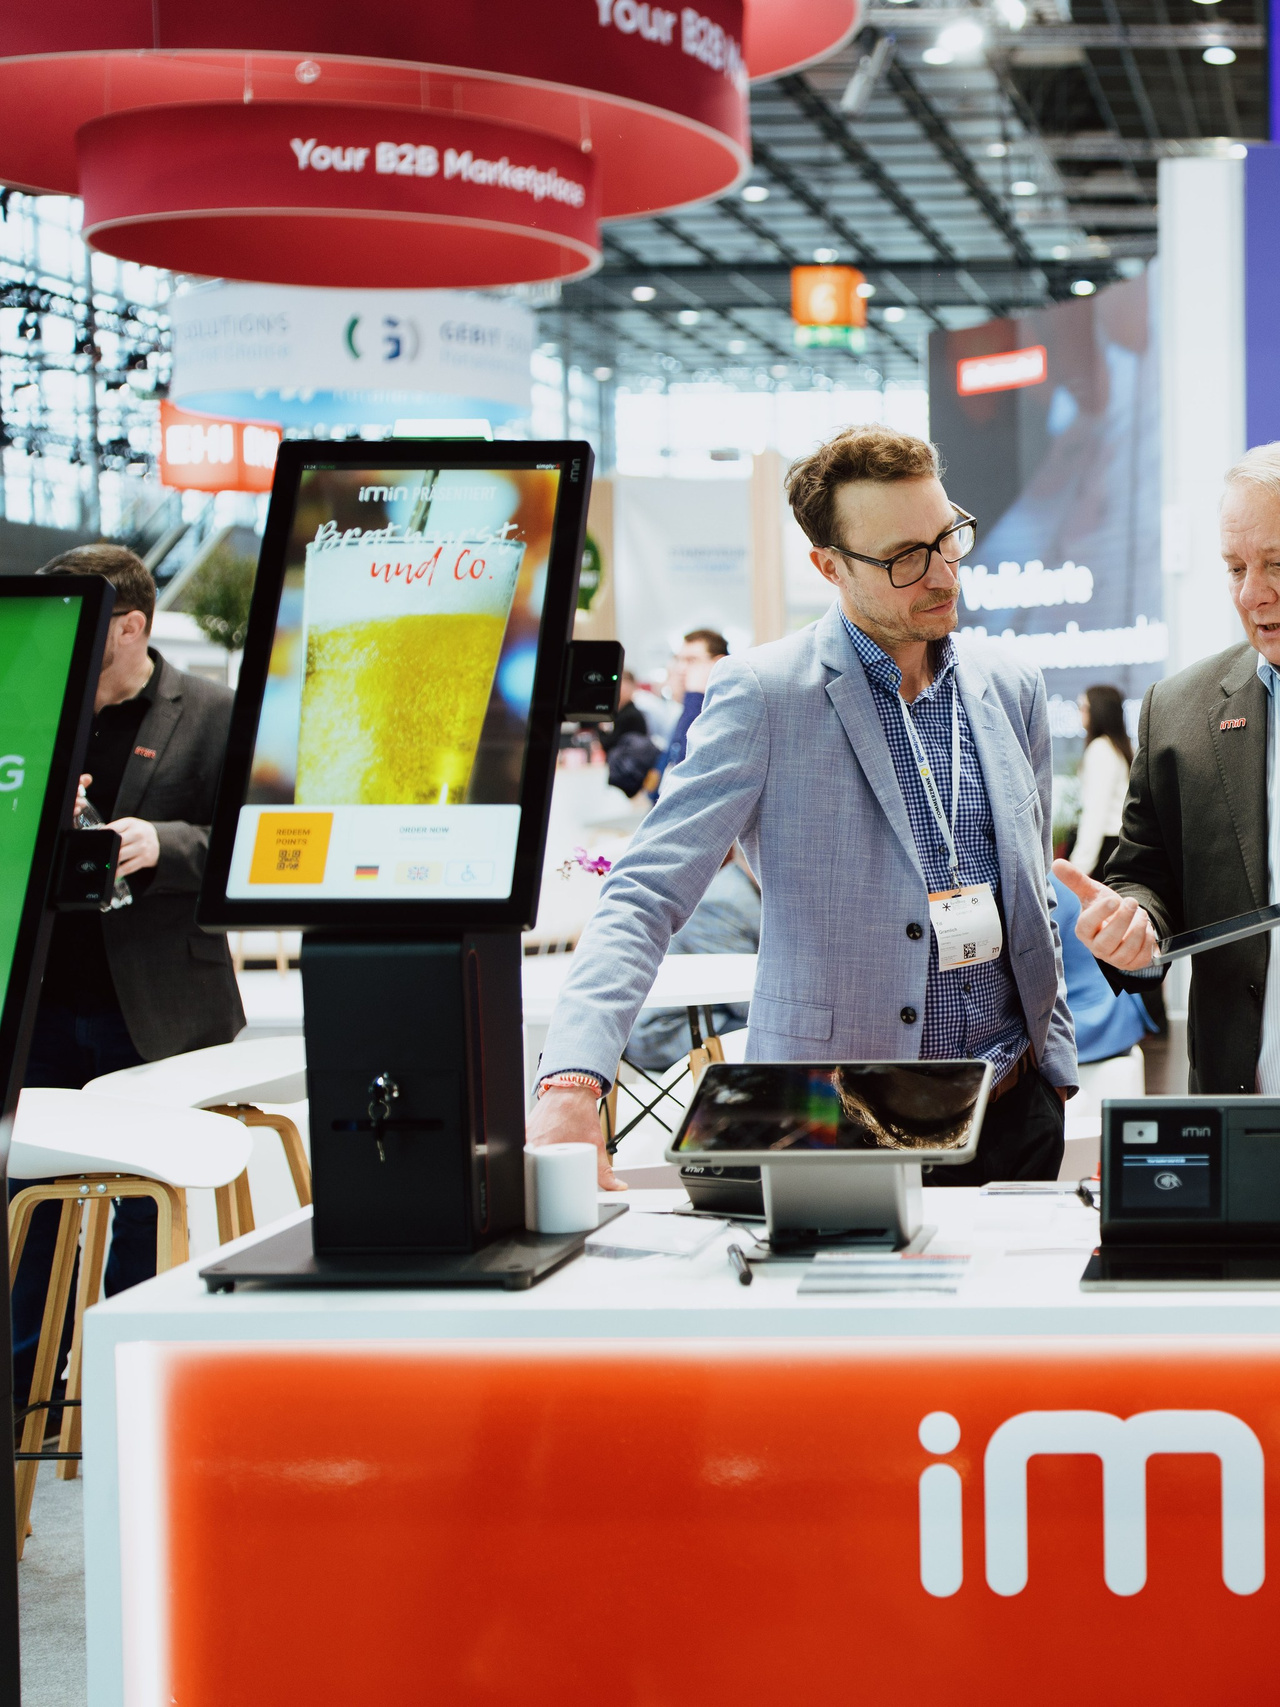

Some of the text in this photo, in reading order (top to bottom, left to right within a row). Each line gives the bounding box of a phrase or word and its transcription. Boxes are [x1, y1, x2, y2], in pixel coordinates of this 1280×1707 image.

[290, 137, 586, 209] Your B2B Marketplace
[411, 484, 498, 501] PRÄSENTIERT
[370, 546, 494, 587] und Co.
